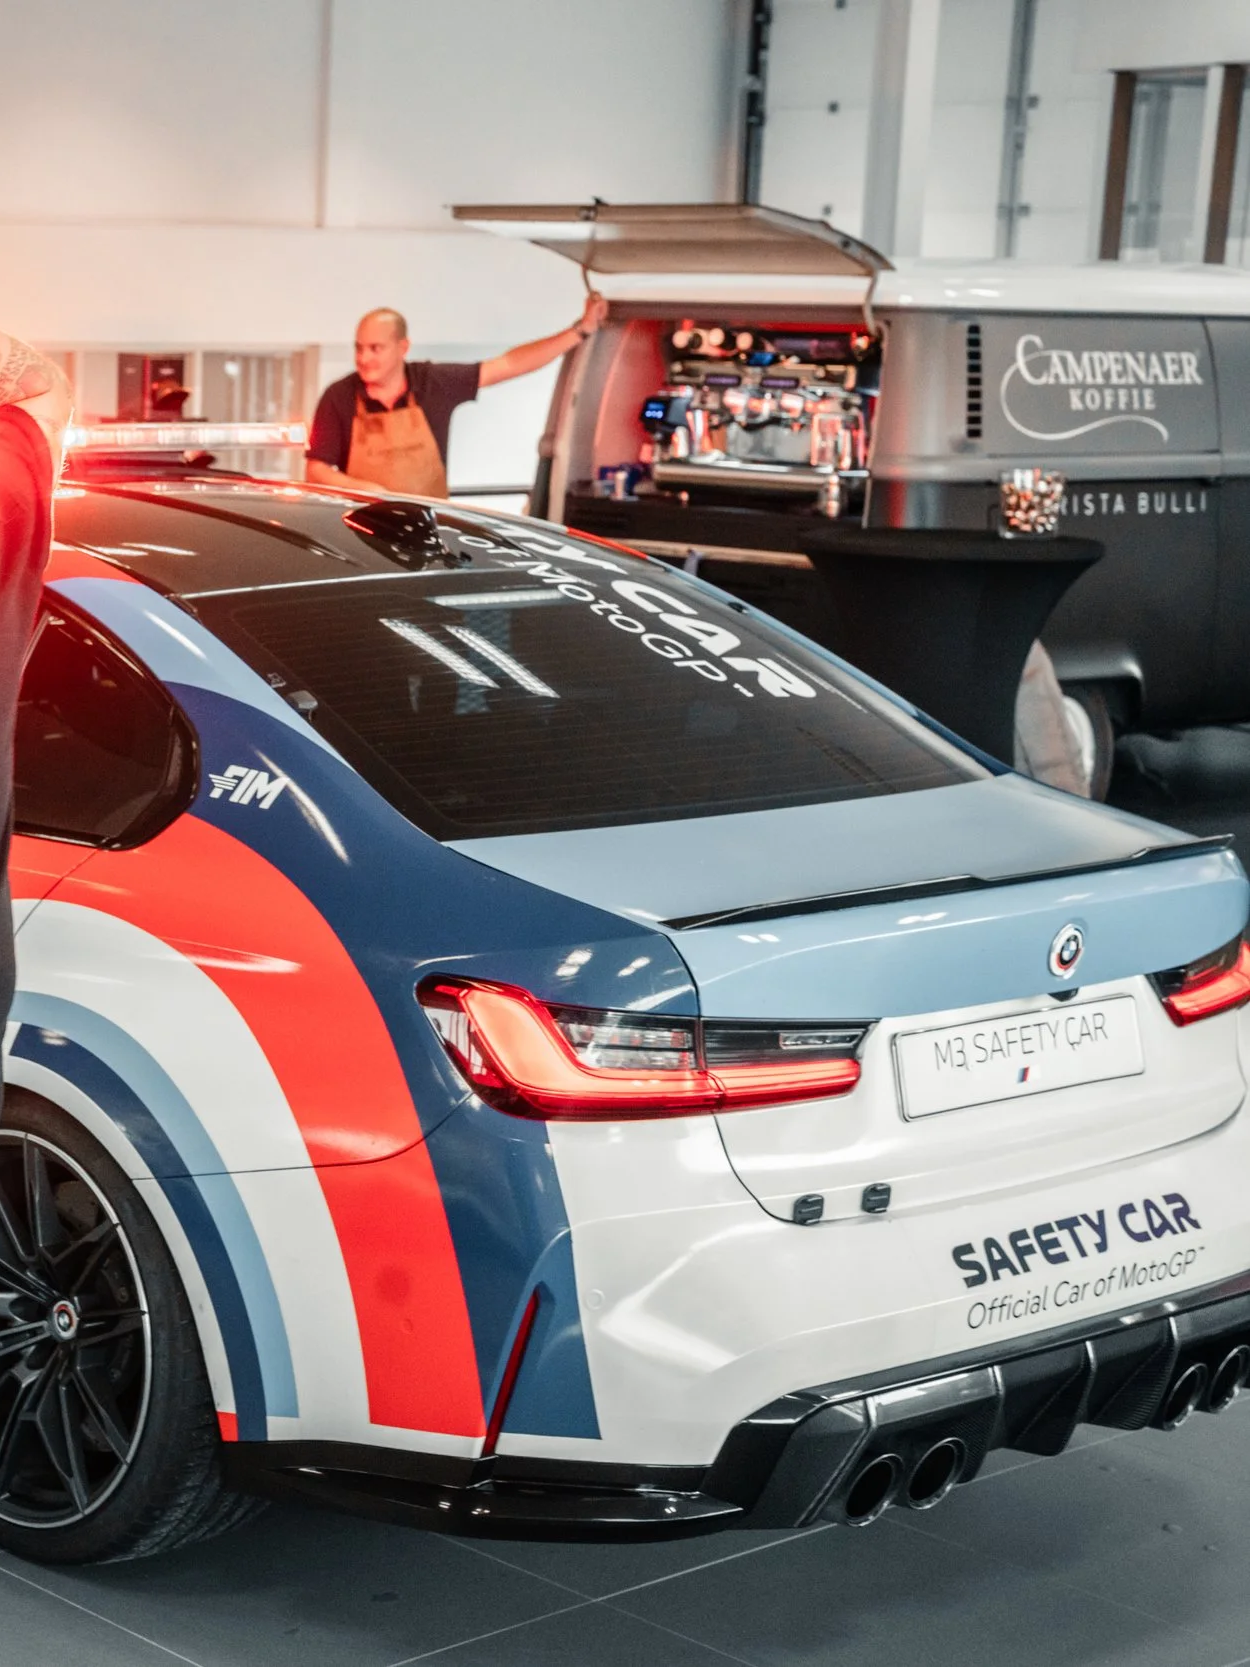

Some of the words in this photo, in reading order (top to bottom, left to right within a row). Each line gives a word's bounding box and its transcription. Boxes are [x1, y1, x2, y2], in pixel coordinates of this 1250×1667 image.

[1016, 334, 1203, 385] CAMPENAER
[1069, 388, 1156, 411] KOFFIE
[1060, 492, 1126, 516] RISTA
[1137, 491, 1207, 514] BULLI
[610, 579, 817, 698] CAR
[208, 764, 290, 810] FIM
[934, 1036, 967, 1071] M3
[972, 1020, 1060, 1064] SAFETY
[1065, 1012, 1109, 1048] CAR
[952, 1208, 1108, 1288] SAFETY
[1118, 1192, 1201, 1243] CAR
[966, 1285, 1047, 1329] Official
[1053, 1281, 1090, 1307] Car
[1093, 1269, 1116, 1297] of
